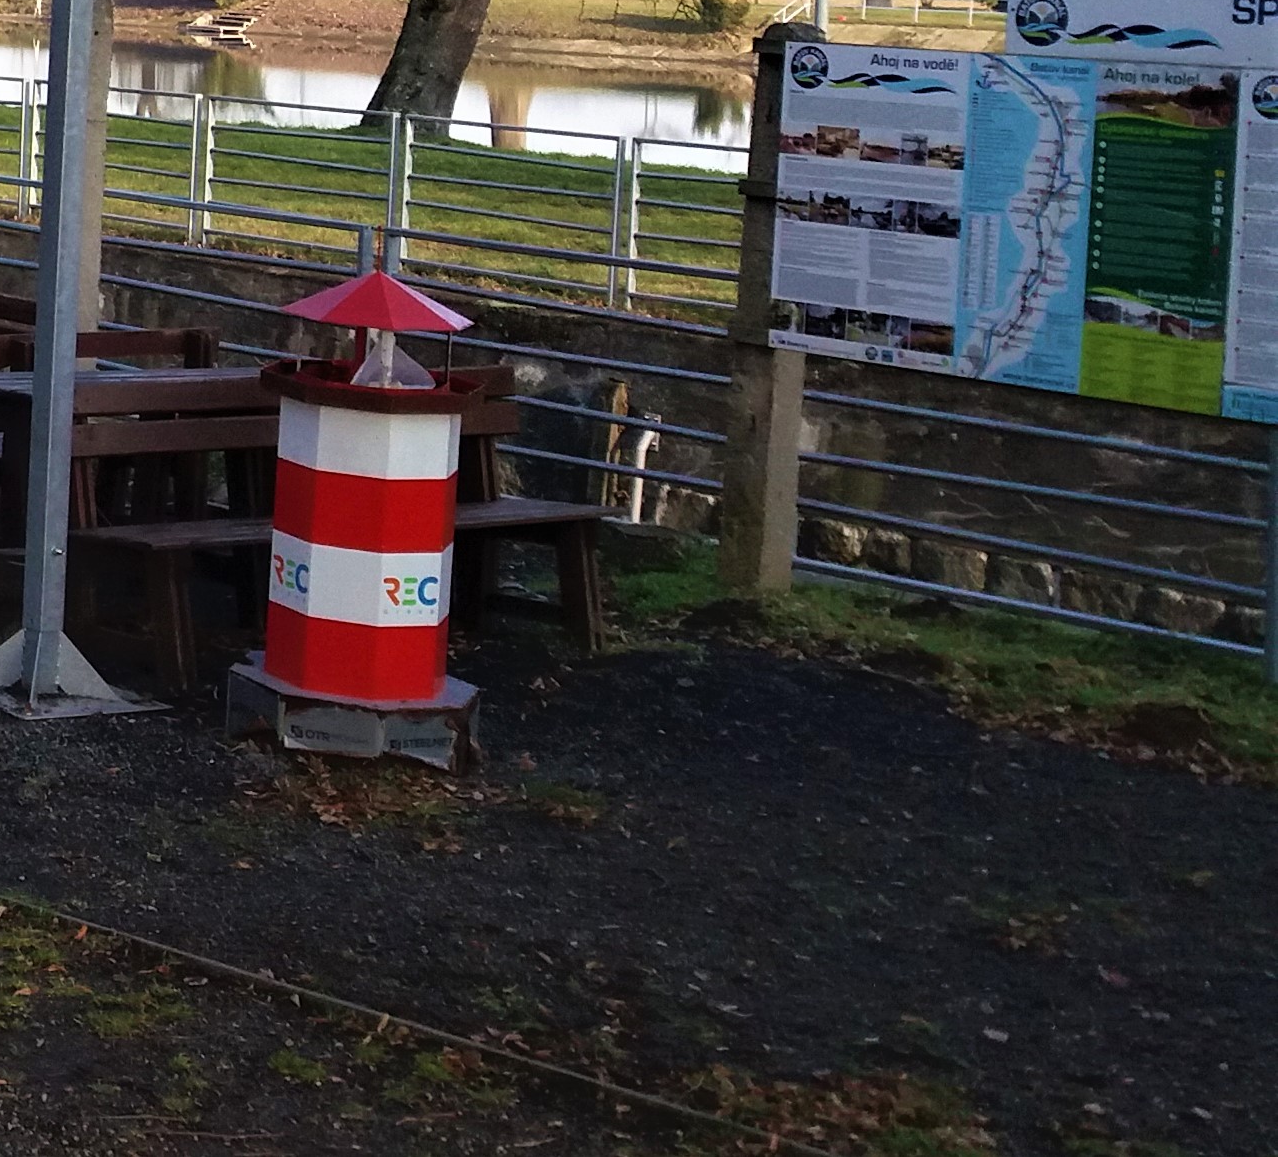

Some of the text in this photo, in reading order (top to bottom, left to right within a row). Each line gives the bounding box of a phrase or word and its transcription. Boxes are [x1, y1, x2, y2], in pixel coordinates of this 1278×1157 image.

[870, 53, 899, 70] Ahoj
[903, 58, 920, 69] na
[1103, 67, 1137, 84] Ahoj
[1141, 72, 1160, 84] na
[1164, 72, 1200, 85] kole!
[273, 554, 309, 594] REC
[382, 576, 439, 607] REC
